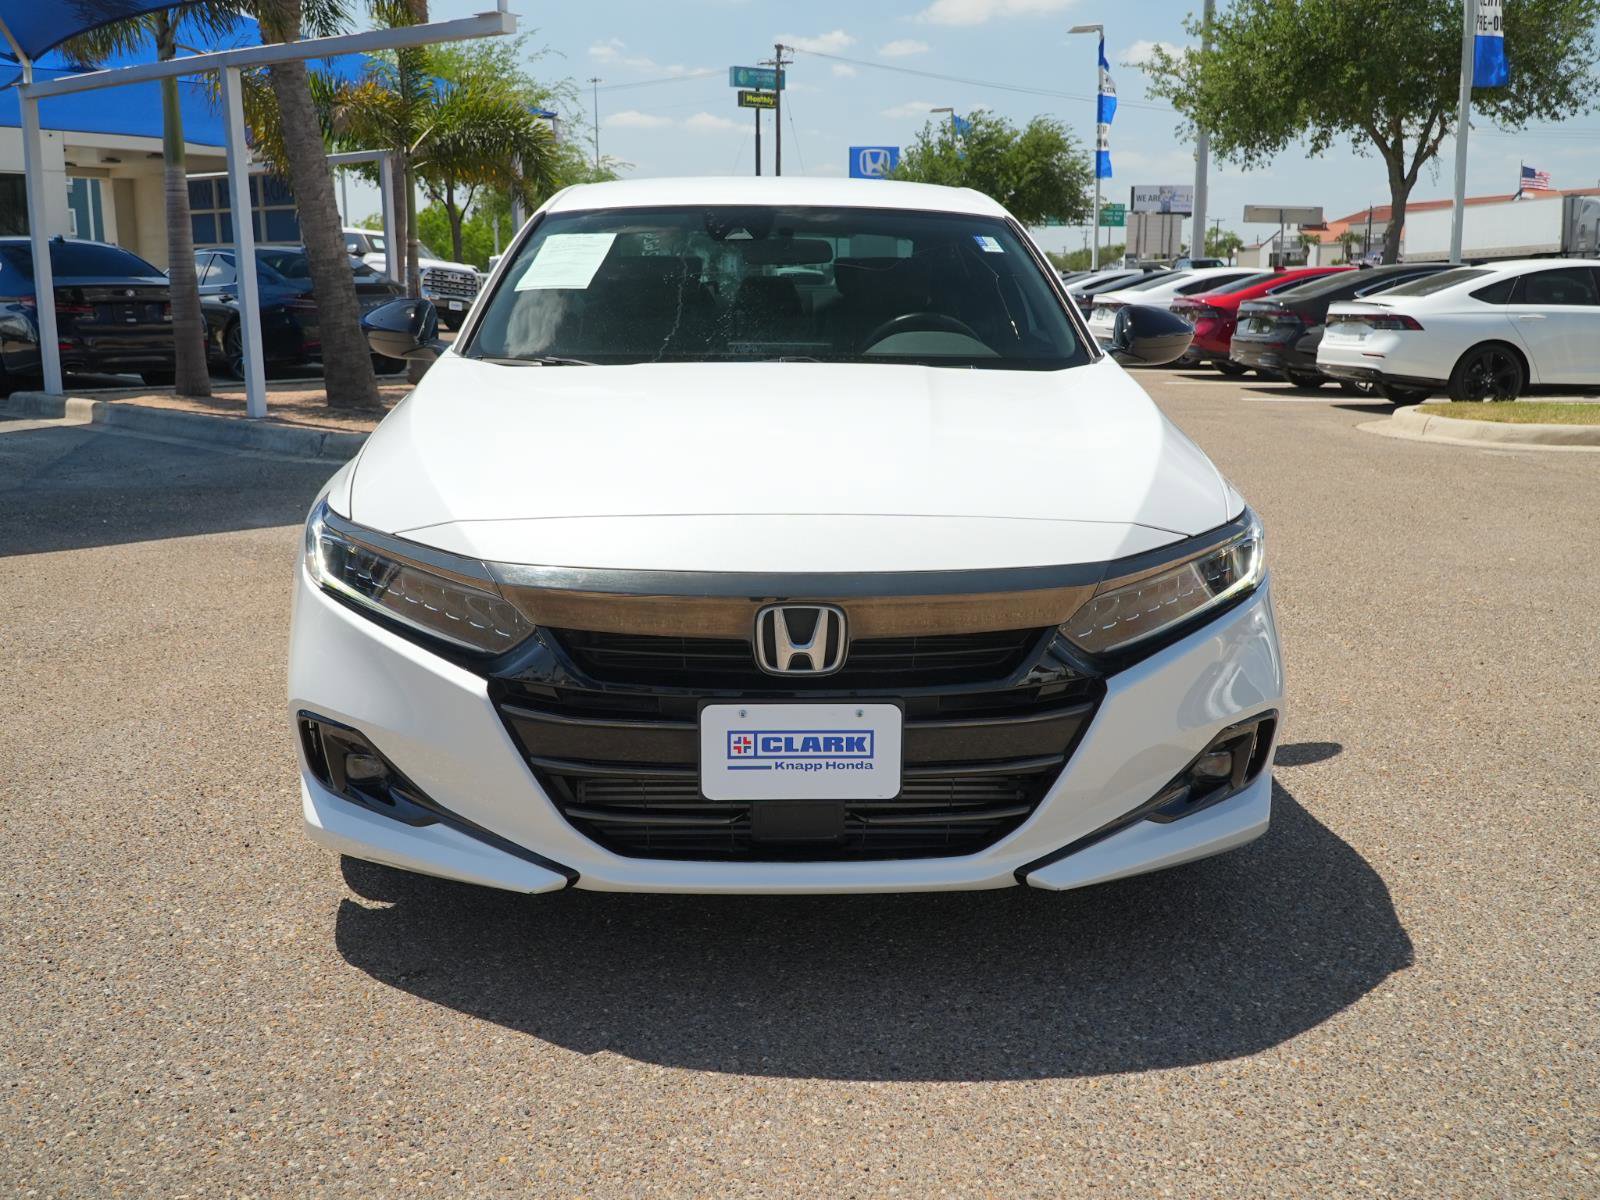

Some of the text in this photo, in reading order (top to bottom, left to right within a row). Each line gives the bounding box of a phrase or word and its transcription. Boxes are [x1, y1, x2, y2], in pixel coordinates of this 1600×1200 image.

[1136, 194, 1147, 202] WE
[761, 736, 867, 753] CLARK
[774, 761, 874, 772] Knapp Honda
